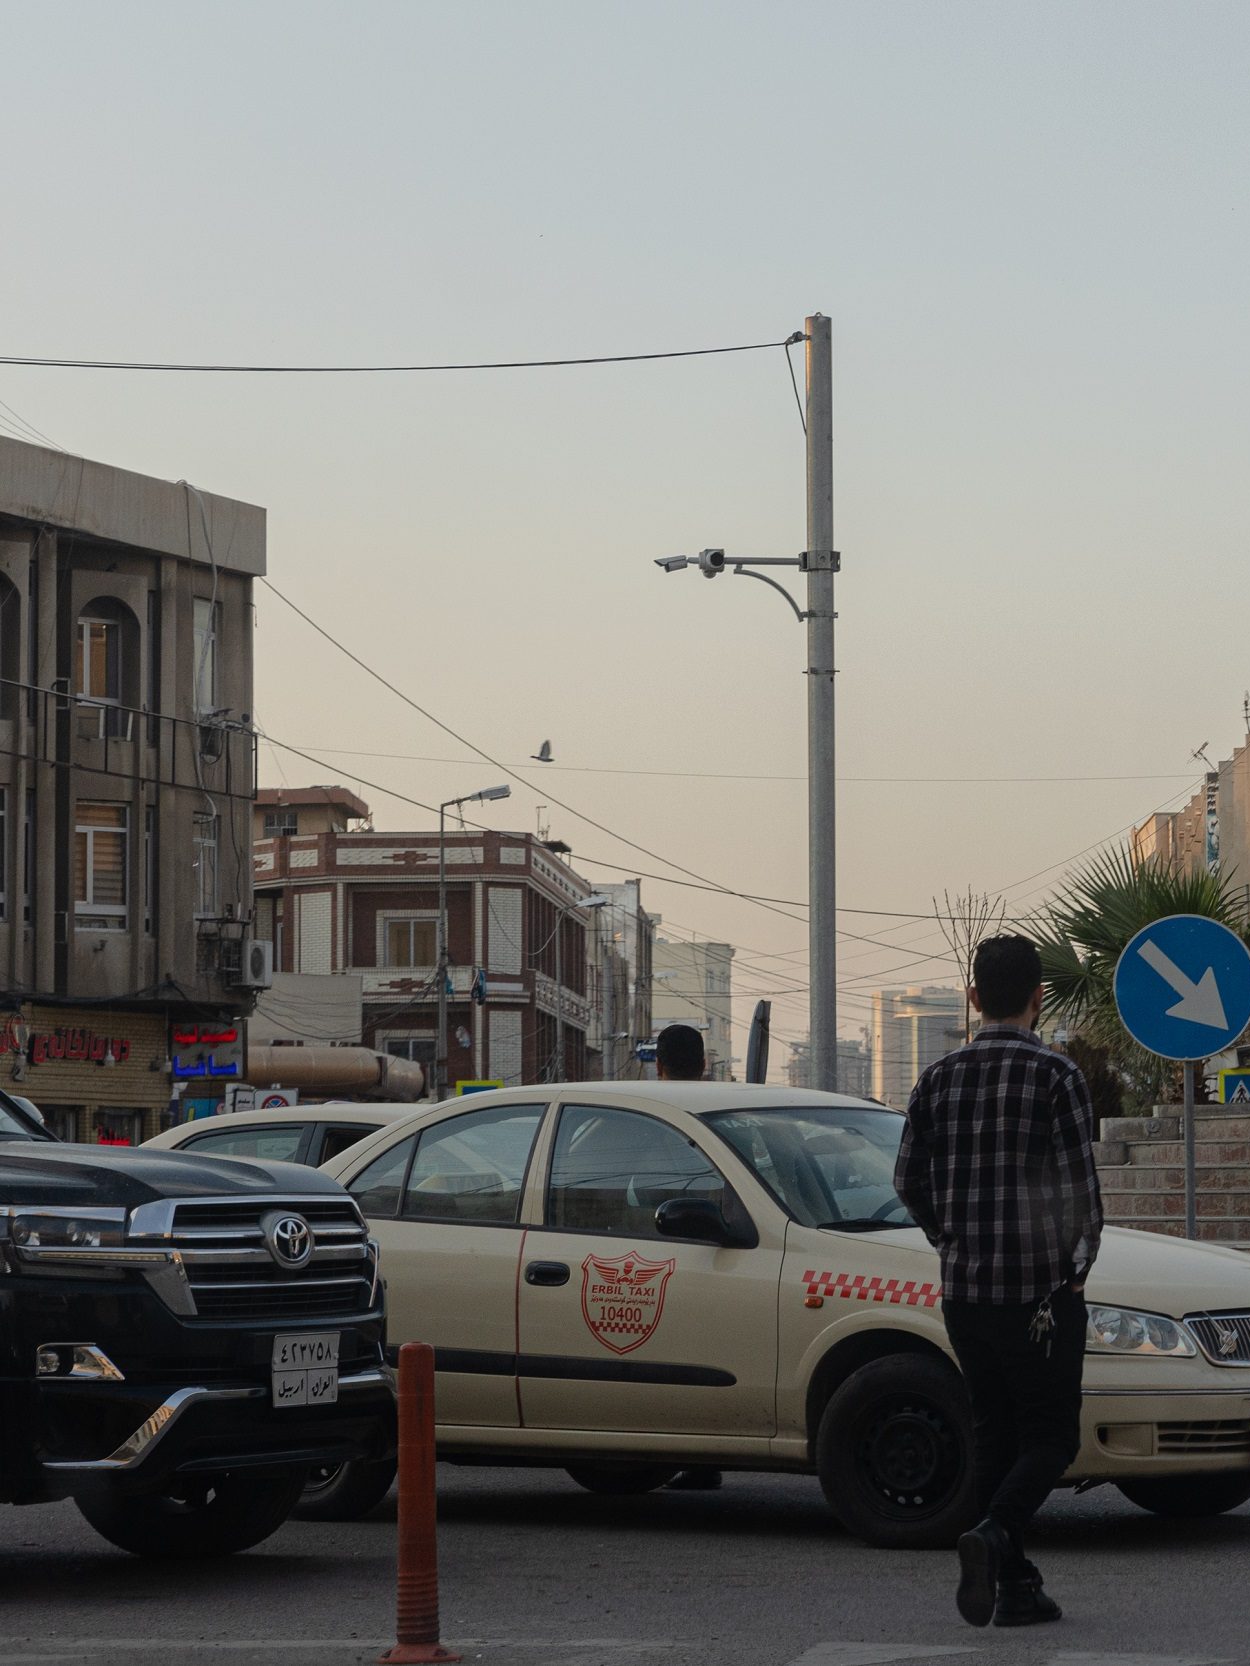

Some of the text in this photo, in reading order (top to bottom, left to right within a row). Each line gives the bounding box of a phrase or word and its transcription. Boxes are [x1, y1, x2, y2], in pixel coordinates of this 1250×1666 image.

[628, 1286, 655, 1297] TAXI
[600, 1306, 642, 1322] 10400
[281, 1342, 332, 1363] ٤٢٣٧٥٨
